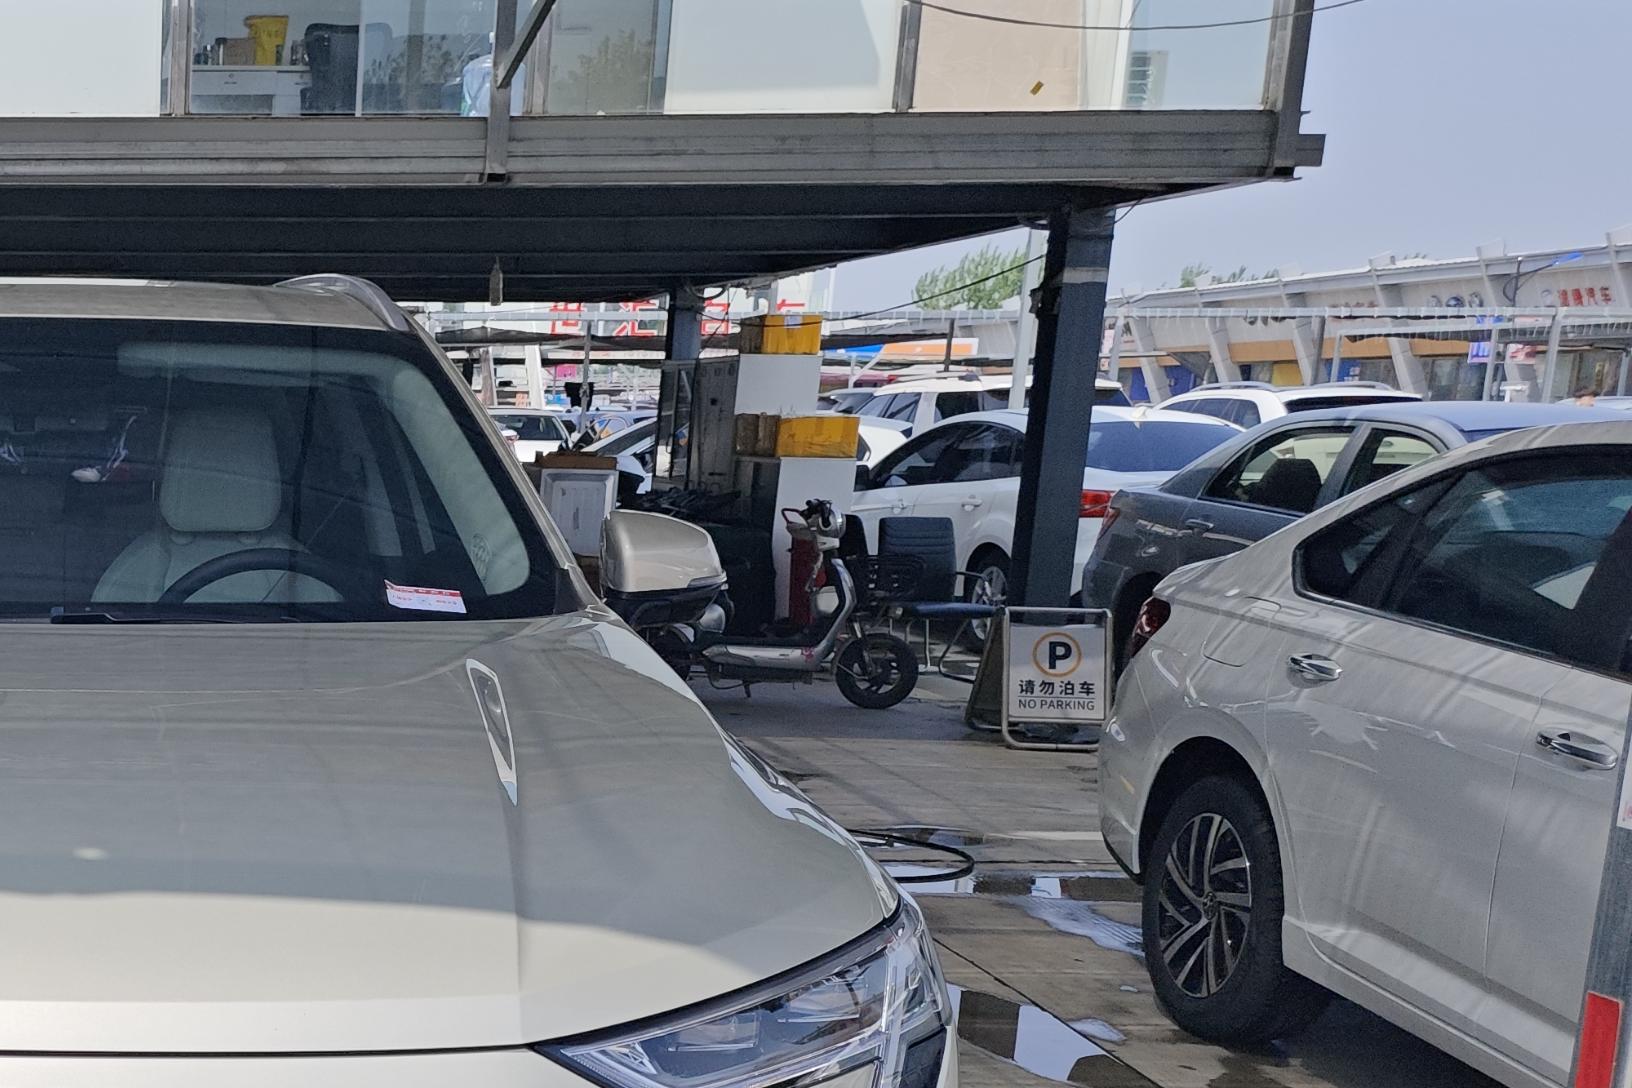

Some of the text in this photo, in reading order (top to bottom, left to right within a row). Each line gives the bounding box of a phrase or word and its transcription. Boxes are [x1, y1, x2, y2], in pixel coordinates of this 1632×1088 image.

[1048, 641, 1072, 669] P
[1018, 679, 1096, 696] 请勿泊车
[1018, 699, 1096, 711] NO PARKING
